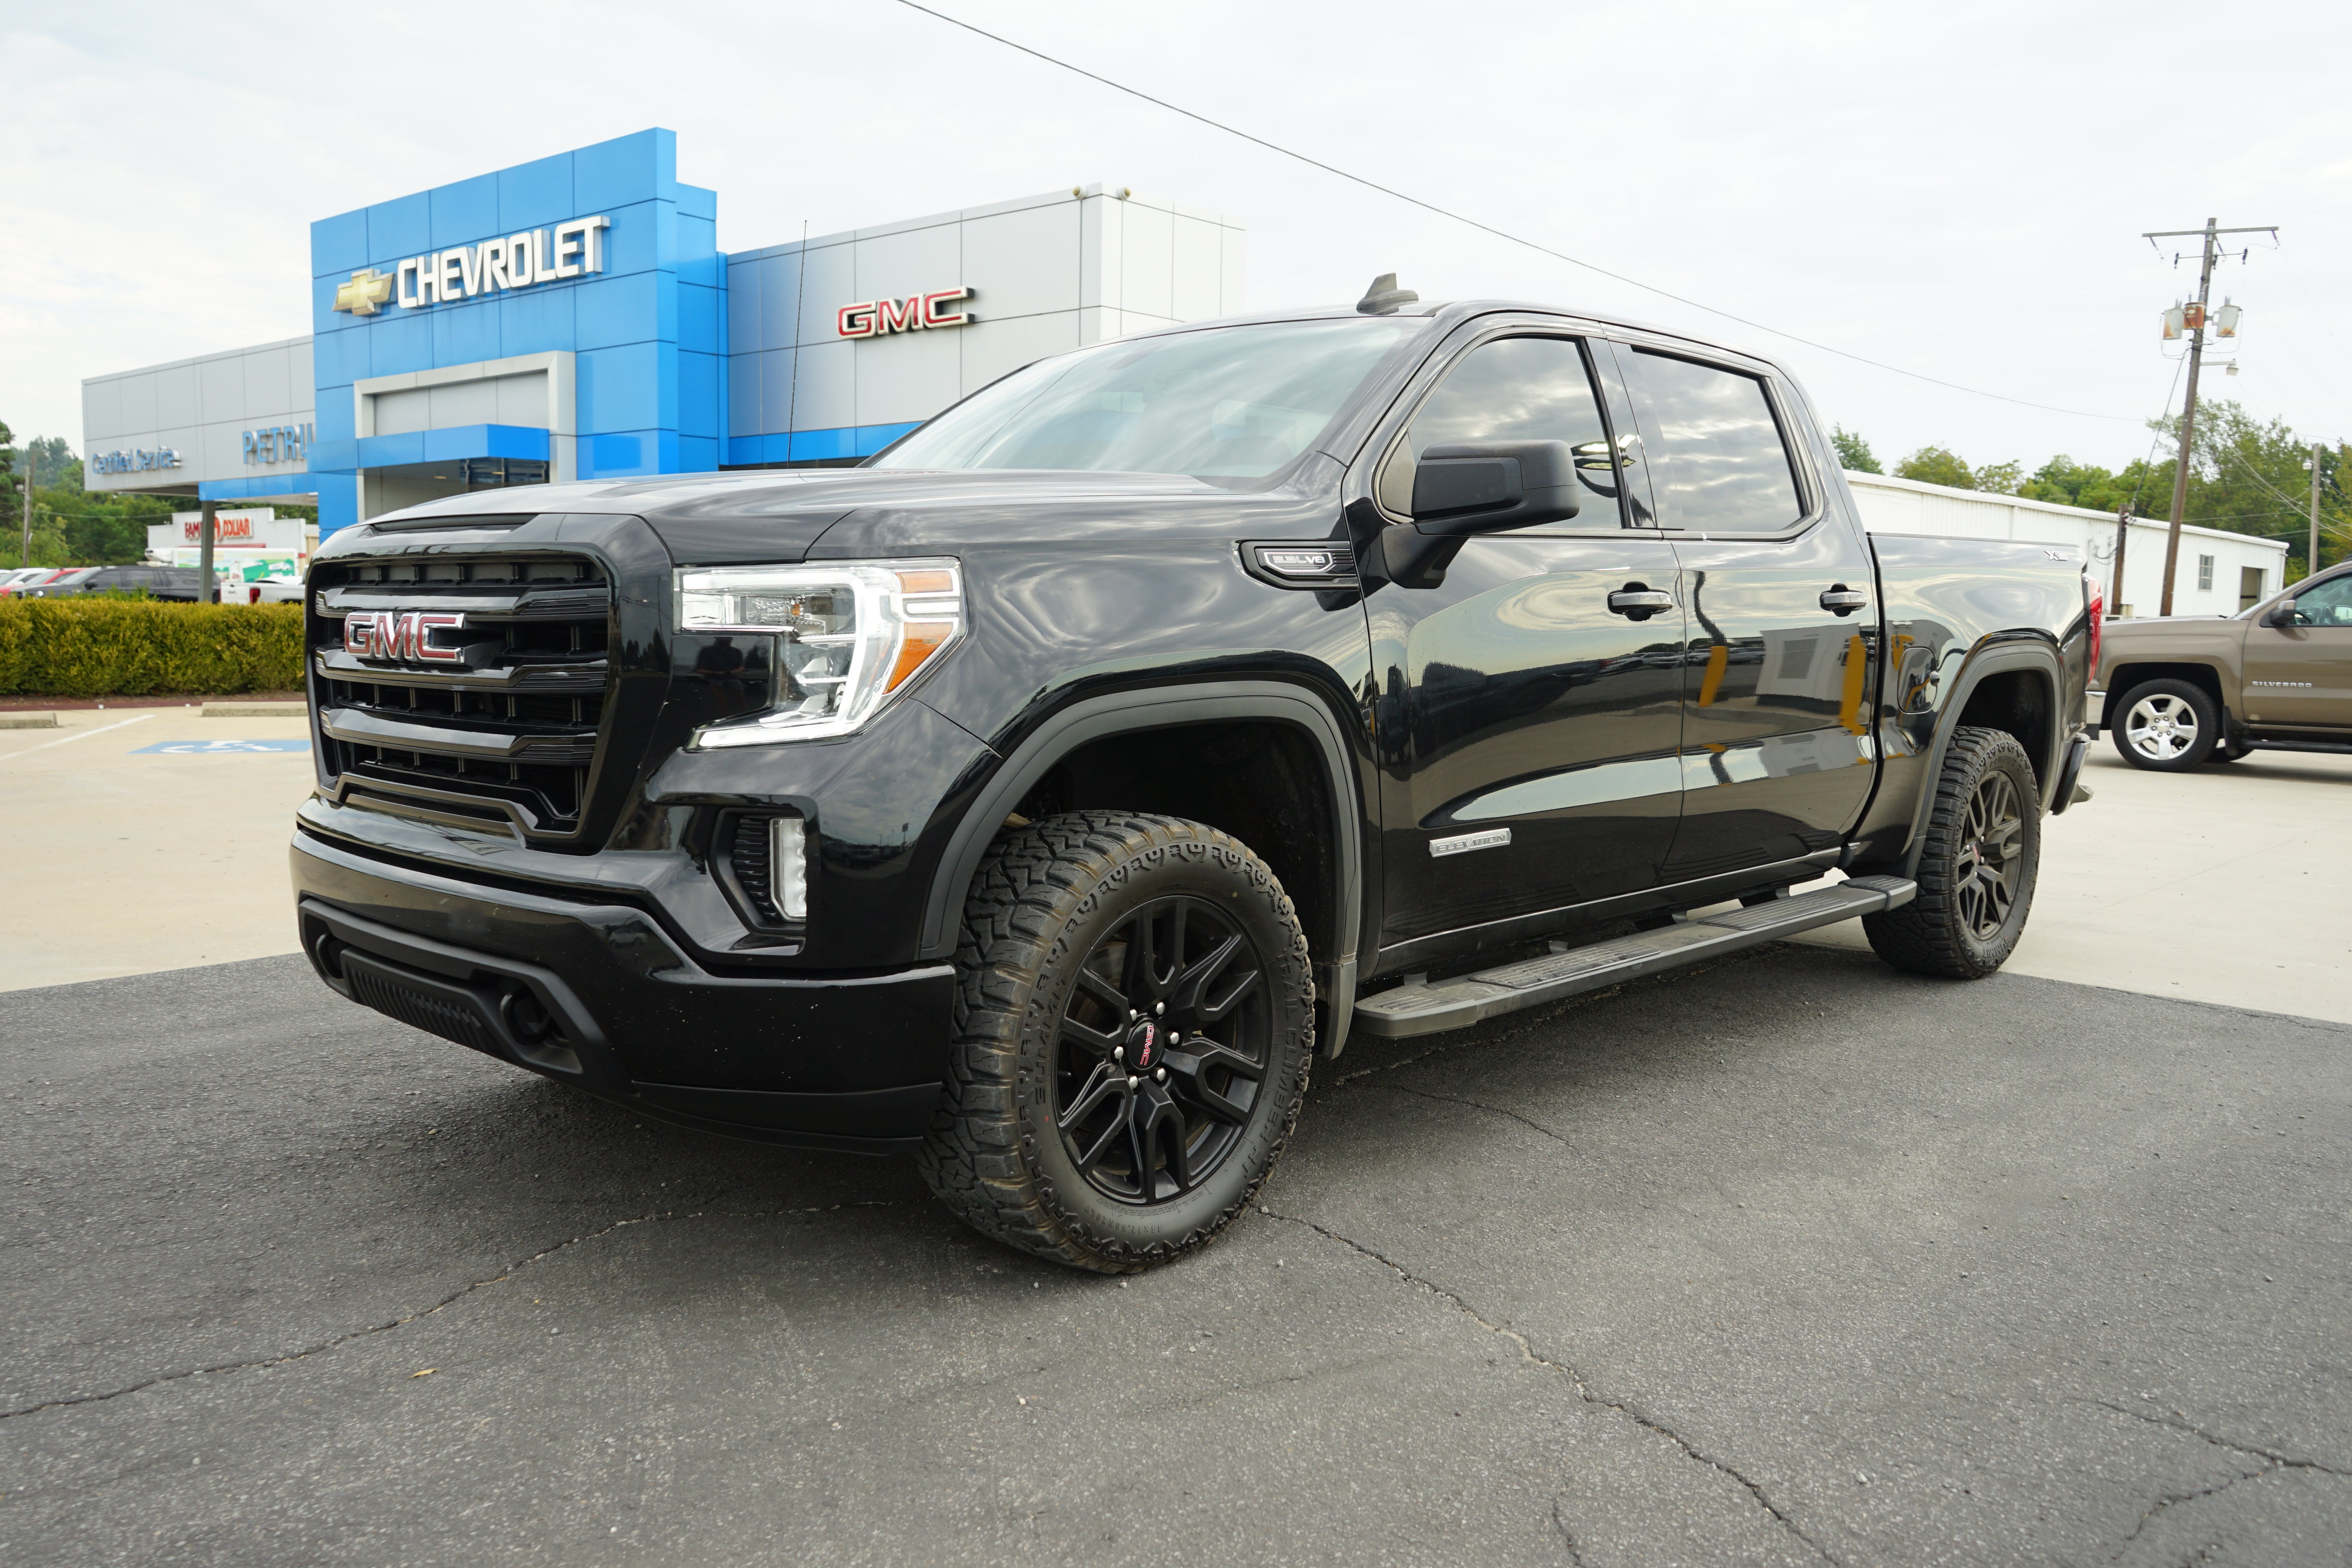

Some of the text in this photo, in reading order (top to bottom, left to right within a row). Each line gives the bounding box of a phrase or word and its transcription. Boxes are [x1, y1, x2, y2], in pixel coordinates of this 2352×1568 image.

[397, 216, 610, 309] CHEVROLET
[837, 285, 974, 340] GMC
[93, 446, 177, 474] Certified Service
[345, 611, 465, 663] GMC
[1437, 834, 1506, 852] ELEVATION
[1277, 948, 1298, 1020] TRAIL
[1140, 1025, 1154, 1065] GMC
[1260, 1028, 1298, 1142] CLIMBER
